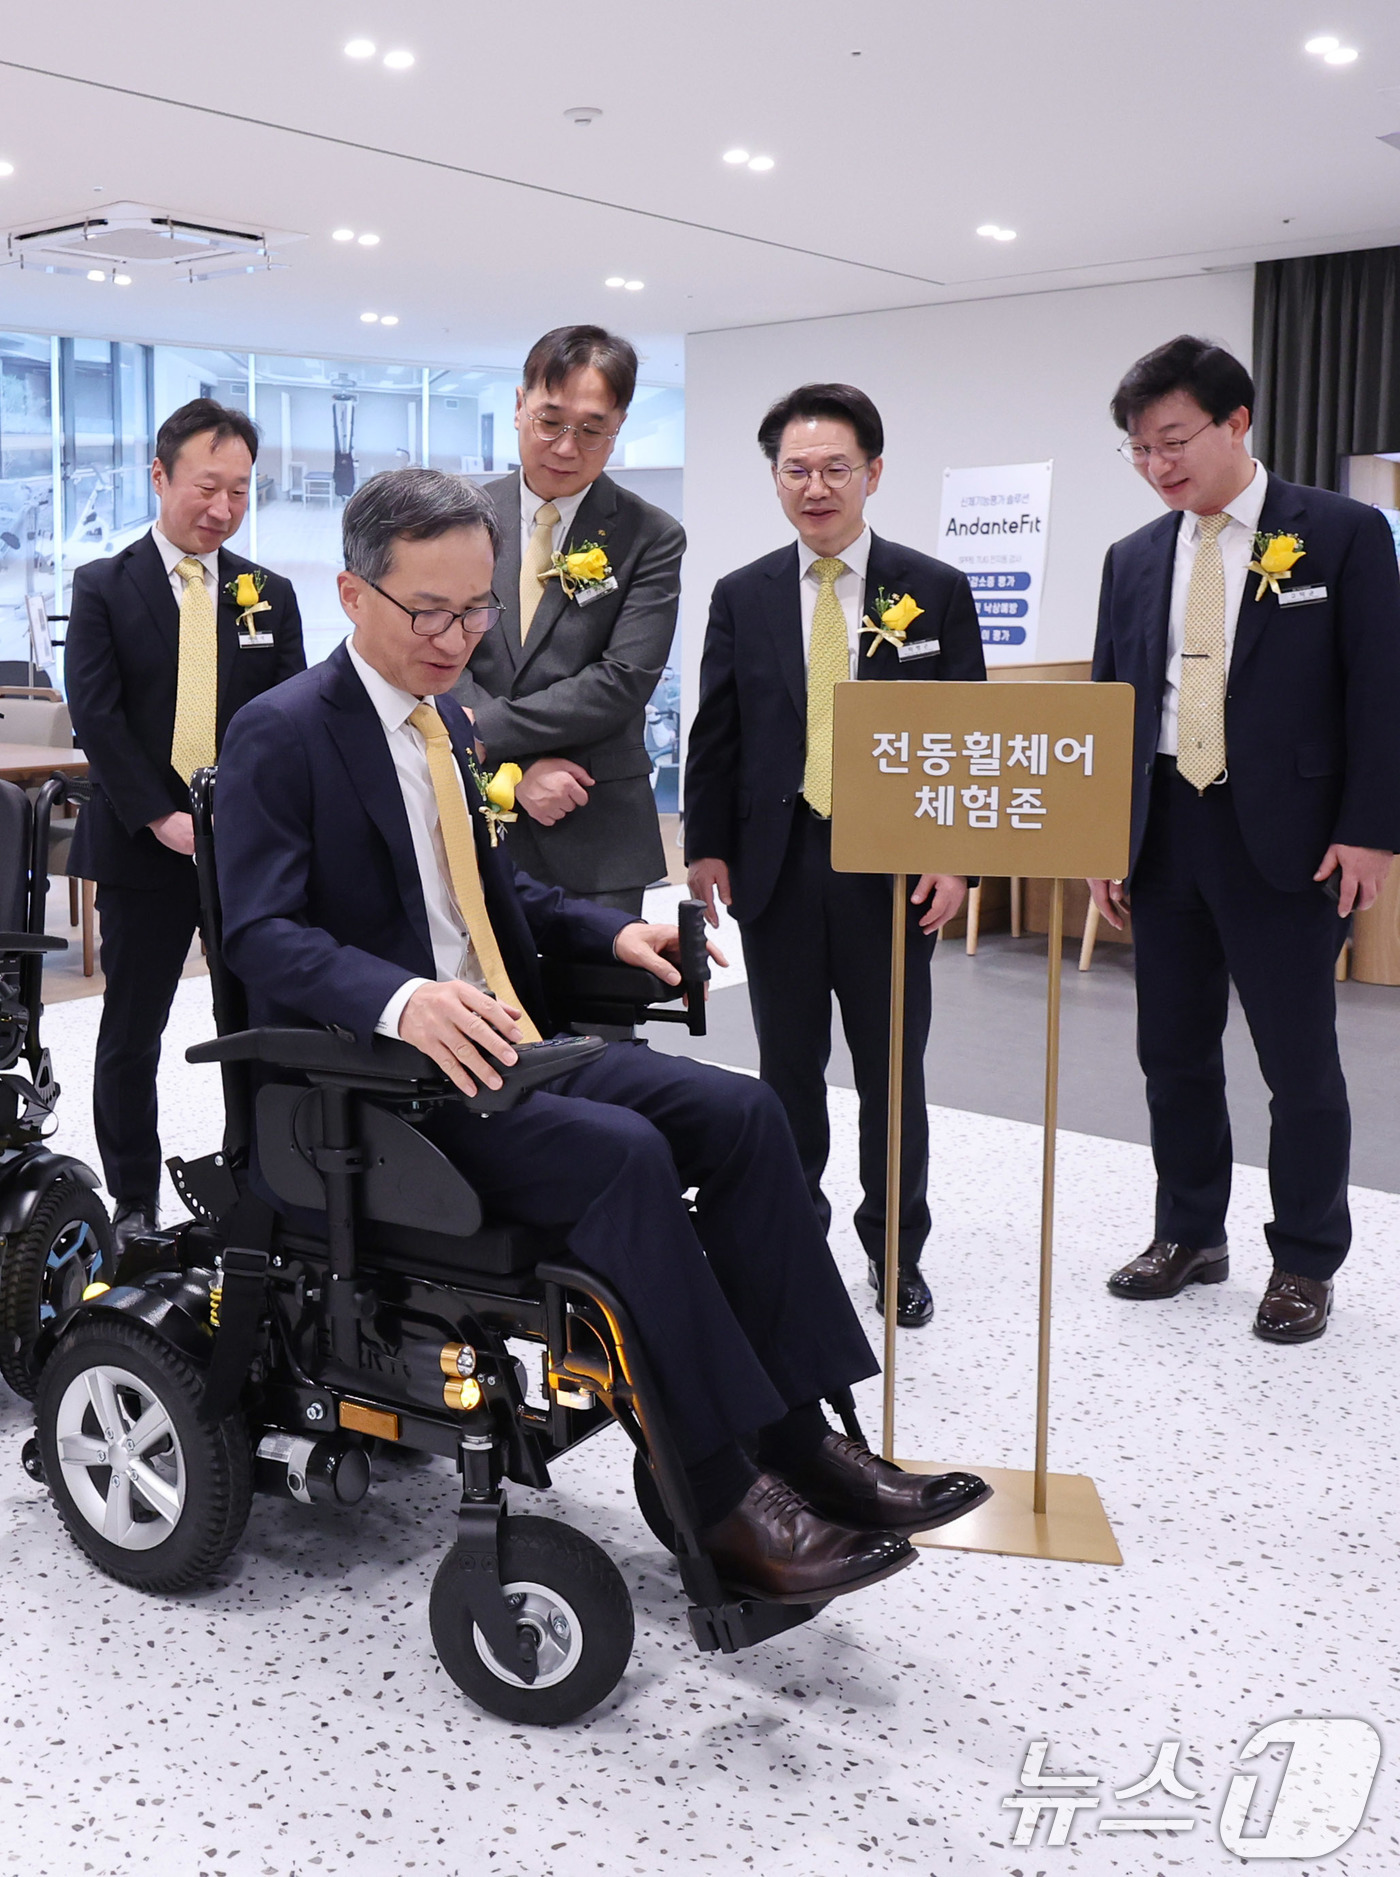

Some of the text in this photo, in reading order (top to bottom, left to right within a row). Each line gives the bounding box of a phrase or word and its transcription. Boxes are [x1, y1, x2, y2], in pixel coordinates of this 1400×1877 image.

[945, 514, 1041, 536] AndanteFit
[967, 576, 1015, 588] 감소증 평가
[983, 602, 1018, 614] 낙상예방
[992, 630, 1010, 641] 평가
[872, 732, 1094, 776] 전동휠체어
[914, 785, 1047, 829] 체험존
